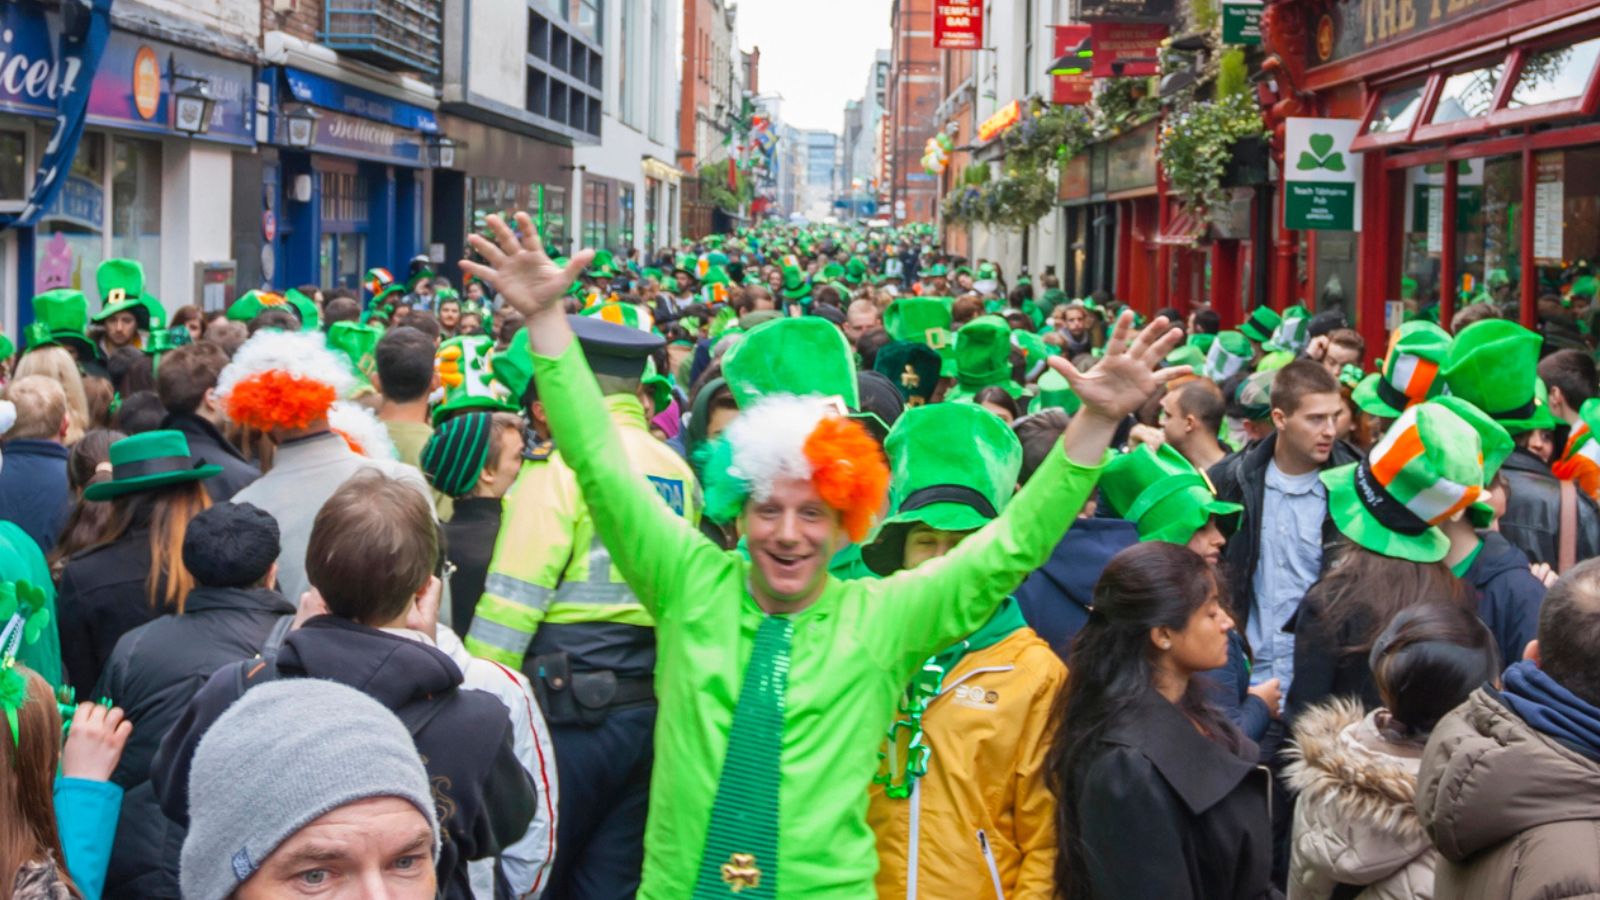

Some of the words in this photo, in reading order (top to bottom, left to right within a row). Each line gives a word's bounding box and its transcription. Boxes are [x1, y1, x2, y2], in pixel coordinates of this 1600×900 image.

[939, 6, 979, 16] TEMPLE
[946, 17, 970, 26] BAR
[1361, 0, 1416, 45] THE
[1313, 196, 1327, 205] Pub
